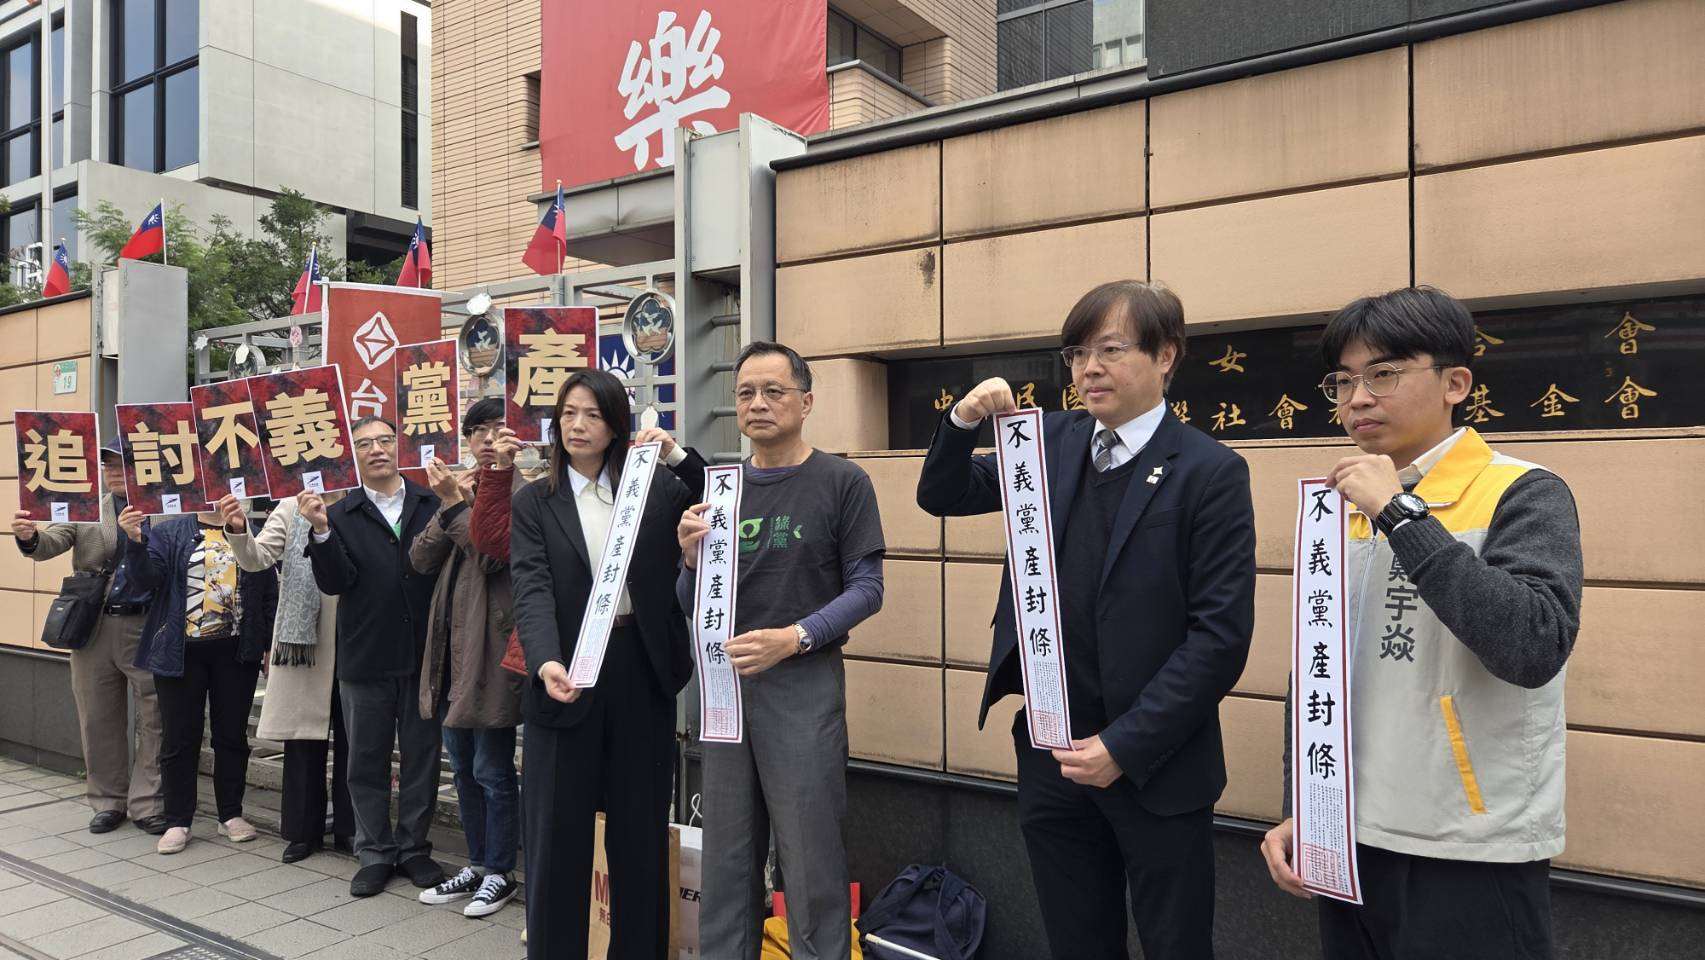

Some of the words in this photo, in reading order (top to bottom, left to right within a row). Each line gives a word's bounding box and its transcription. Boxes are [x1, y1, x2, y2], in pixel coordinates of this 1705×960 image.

[614, 10, 730, 170] 樂
[351, 378, 389, 421] 台
[402, 361, 453, 436] 黨
[513, 327, 588, 409] 產
[24, 428, 93, 494] 追
[128, 420, 200, 487] 討
[201, 400, 259, 470] 不
[265, 388, 346, 468] 義
[594, 448, 650, 616] 不義黨產封條
[704, 473, 732, 665] 不義黨產封條
[1007, 420, 1052, 657] 不義黨產封條
[1307, 489, 1337, 780] 不義黨產封條
